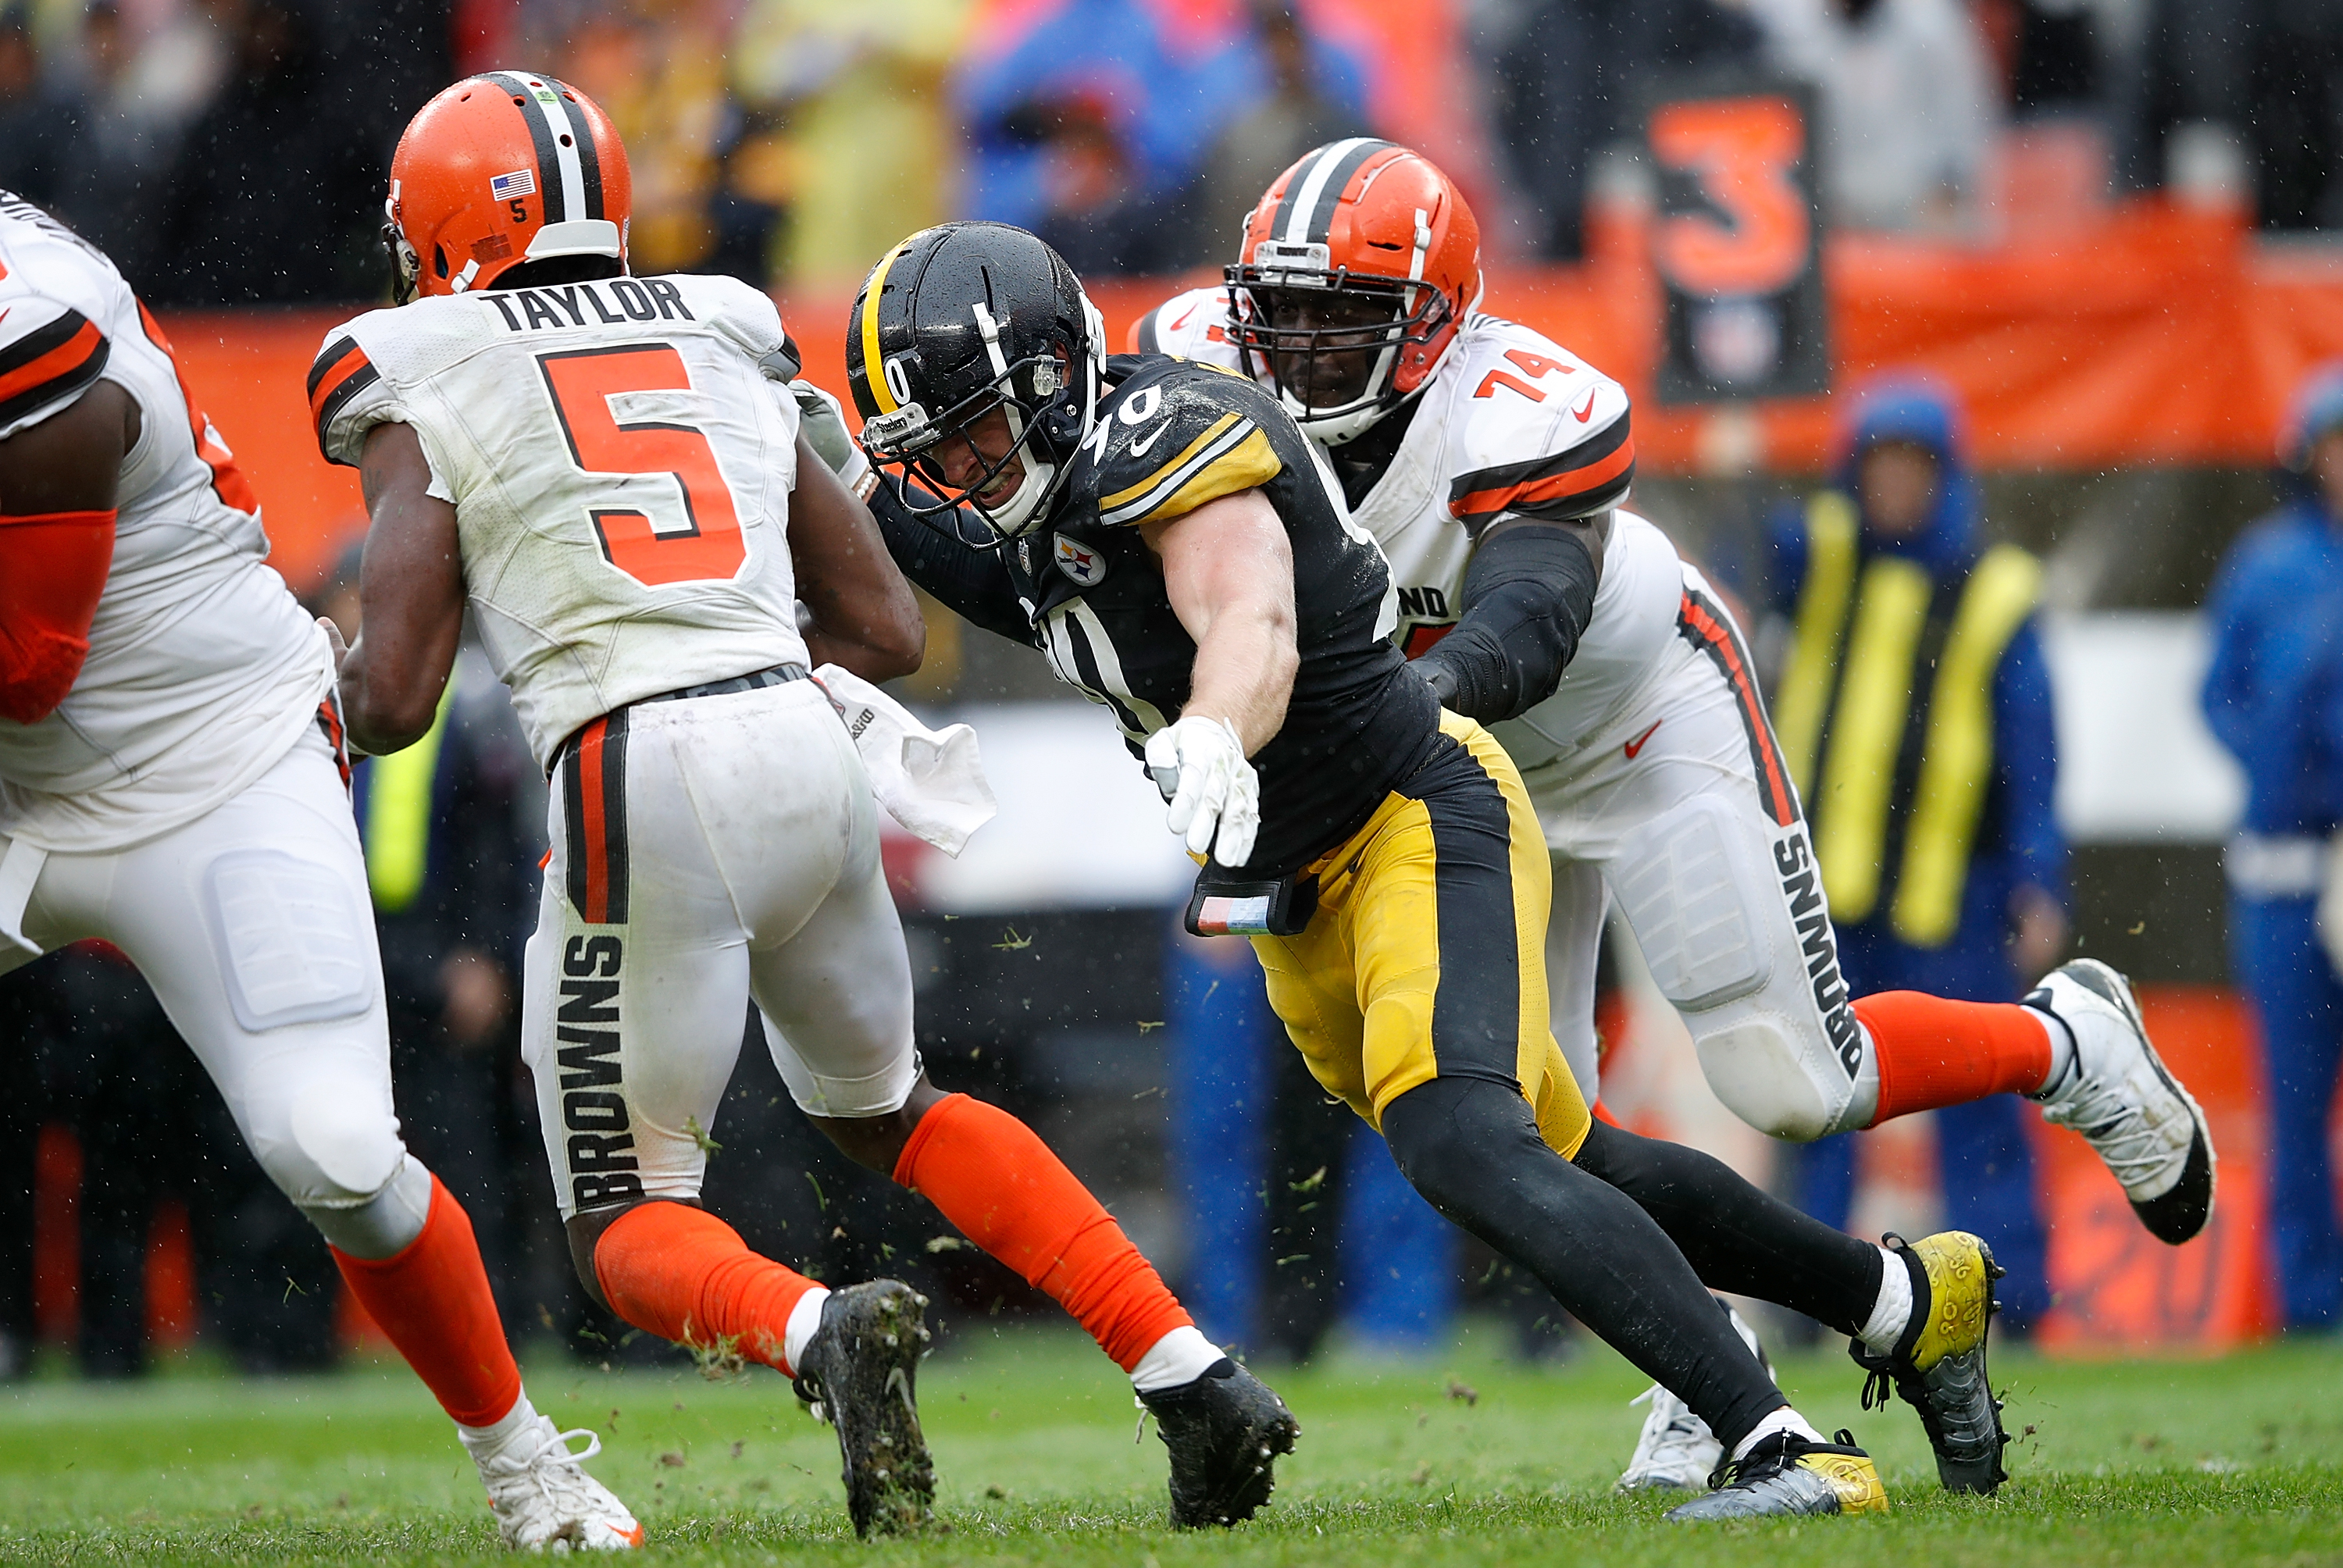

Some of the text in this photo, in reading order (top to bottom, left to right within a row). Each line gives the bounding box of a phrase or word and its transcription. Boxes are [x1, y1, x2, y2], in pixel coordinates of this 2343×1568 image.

[509, 198, 528, 223] 5
[1648, 95, 1812, 295] 3
[478, 280, 696, 331] TAYLOR
[876, 415, 908, 434] Steelers
[1472, 348, 1577, 403] 74
[530, 339, 751, 590] 5
[1773, 833, 1863, 1082] BROWNS
[557, 935, 646, 1215] BROWNS
